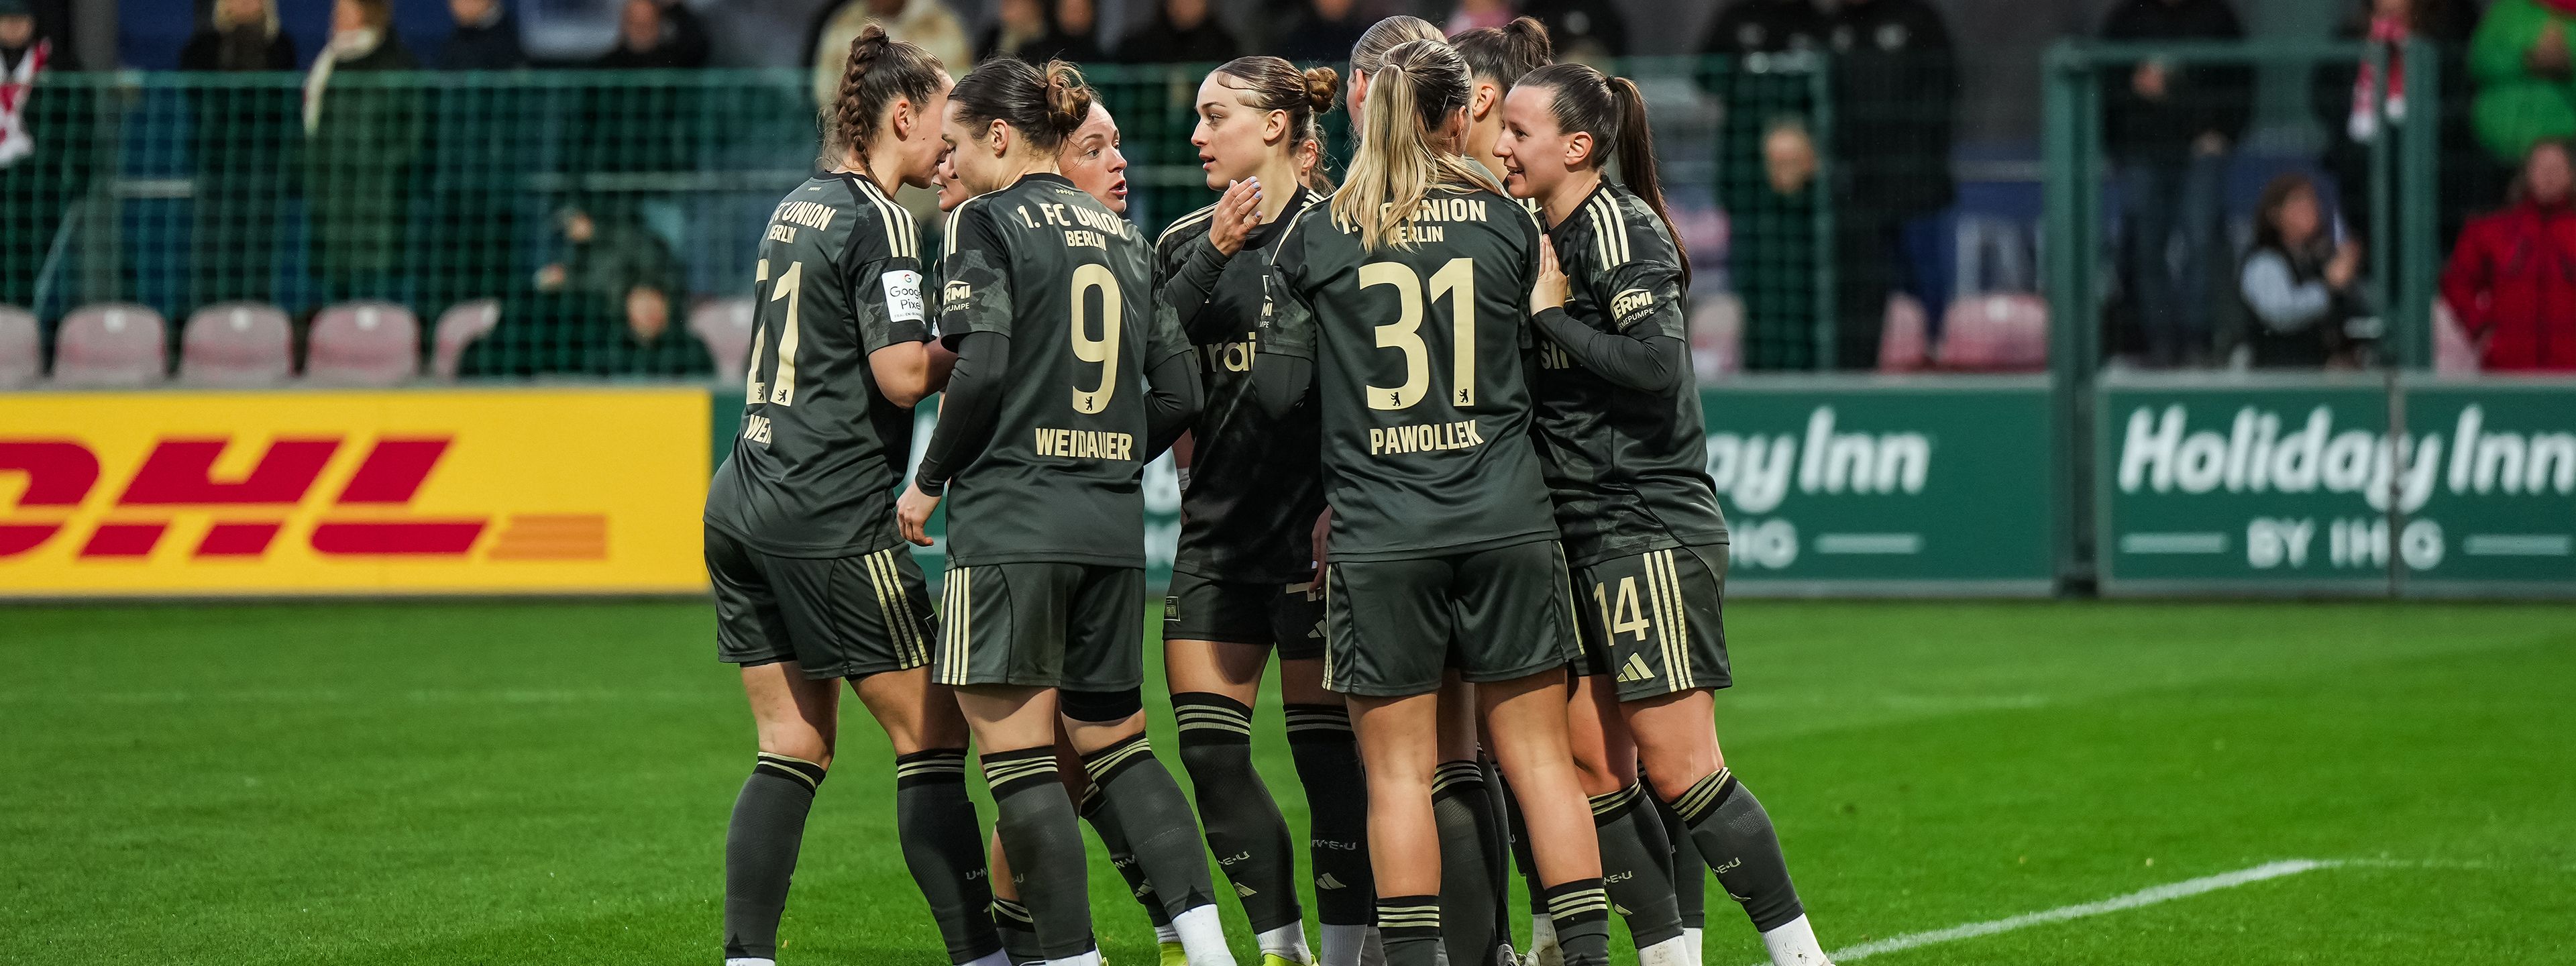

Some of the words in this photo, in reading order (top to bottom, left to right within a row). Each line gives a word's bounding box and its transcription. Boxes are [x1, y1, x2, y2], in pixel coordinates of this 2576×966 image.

[782, 201, 837, 231] UNION
[1017, 205, 1041, 228] 1.
[1039, 203, 1071, 226] FC
[1071, 204, 1130, 241] UNION
[1065, 230, 1107, 252] BERLIN
[1071, 264, 1121, 415] 9
[1358, 258, 1474, 411] 31
[1035, 427, 1133, 461] WEIDAUER
[1369, 419, 1485, 455] PAWOLLEK
[1799, 405, 1931, 496] Inn
[2117, 404, 2444, 514] Holiday
[2447, 403, 2576, 496] Inn
[0, 433, 492, 561] DHL
[2247, 517, 2315, 568] BY
[1594, 576, 1650, 646] 14
